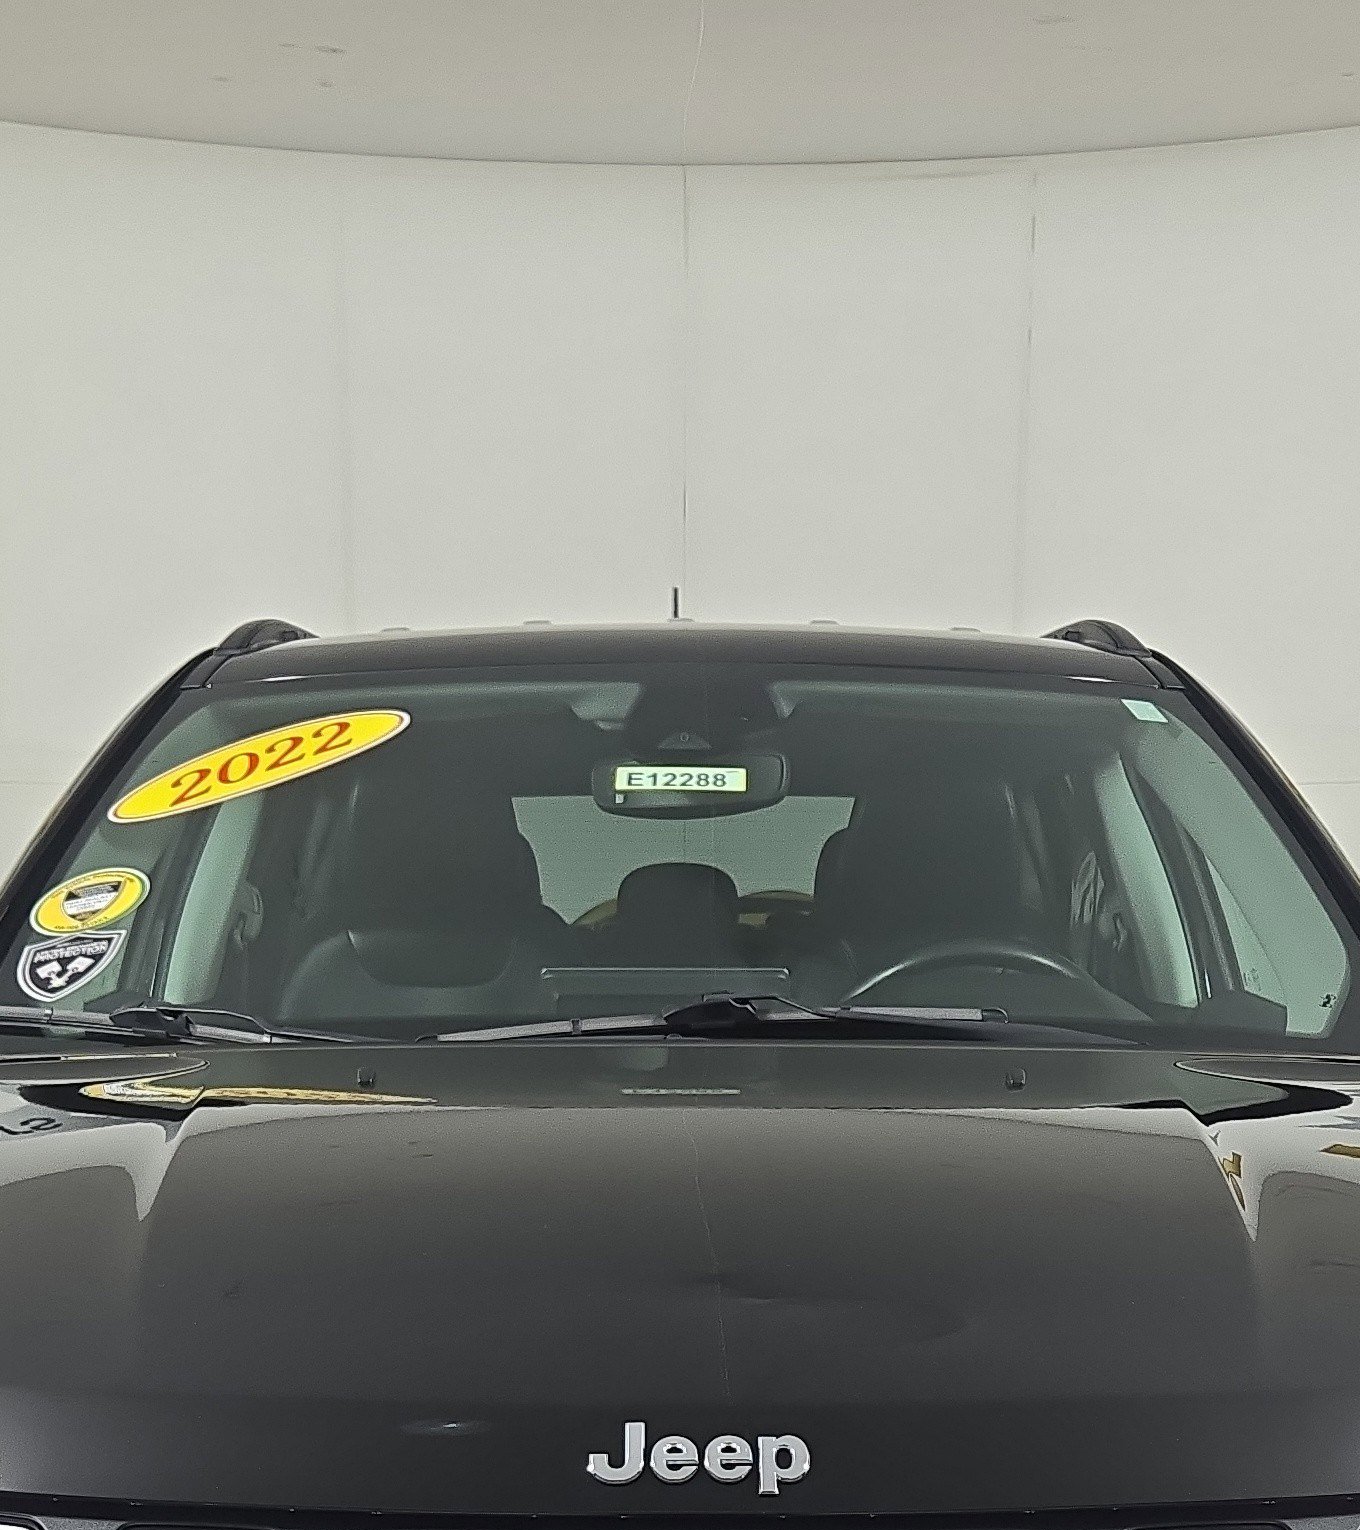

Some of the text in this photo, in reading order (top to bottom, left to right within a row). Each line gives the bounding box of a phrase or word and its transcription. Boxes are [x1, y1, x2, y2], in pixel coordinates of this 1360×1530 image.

[168, 721, 352, 807] 2022
[627, 773, 727, 787] E12288
[586, 1421, 810, 1495] Jeep
